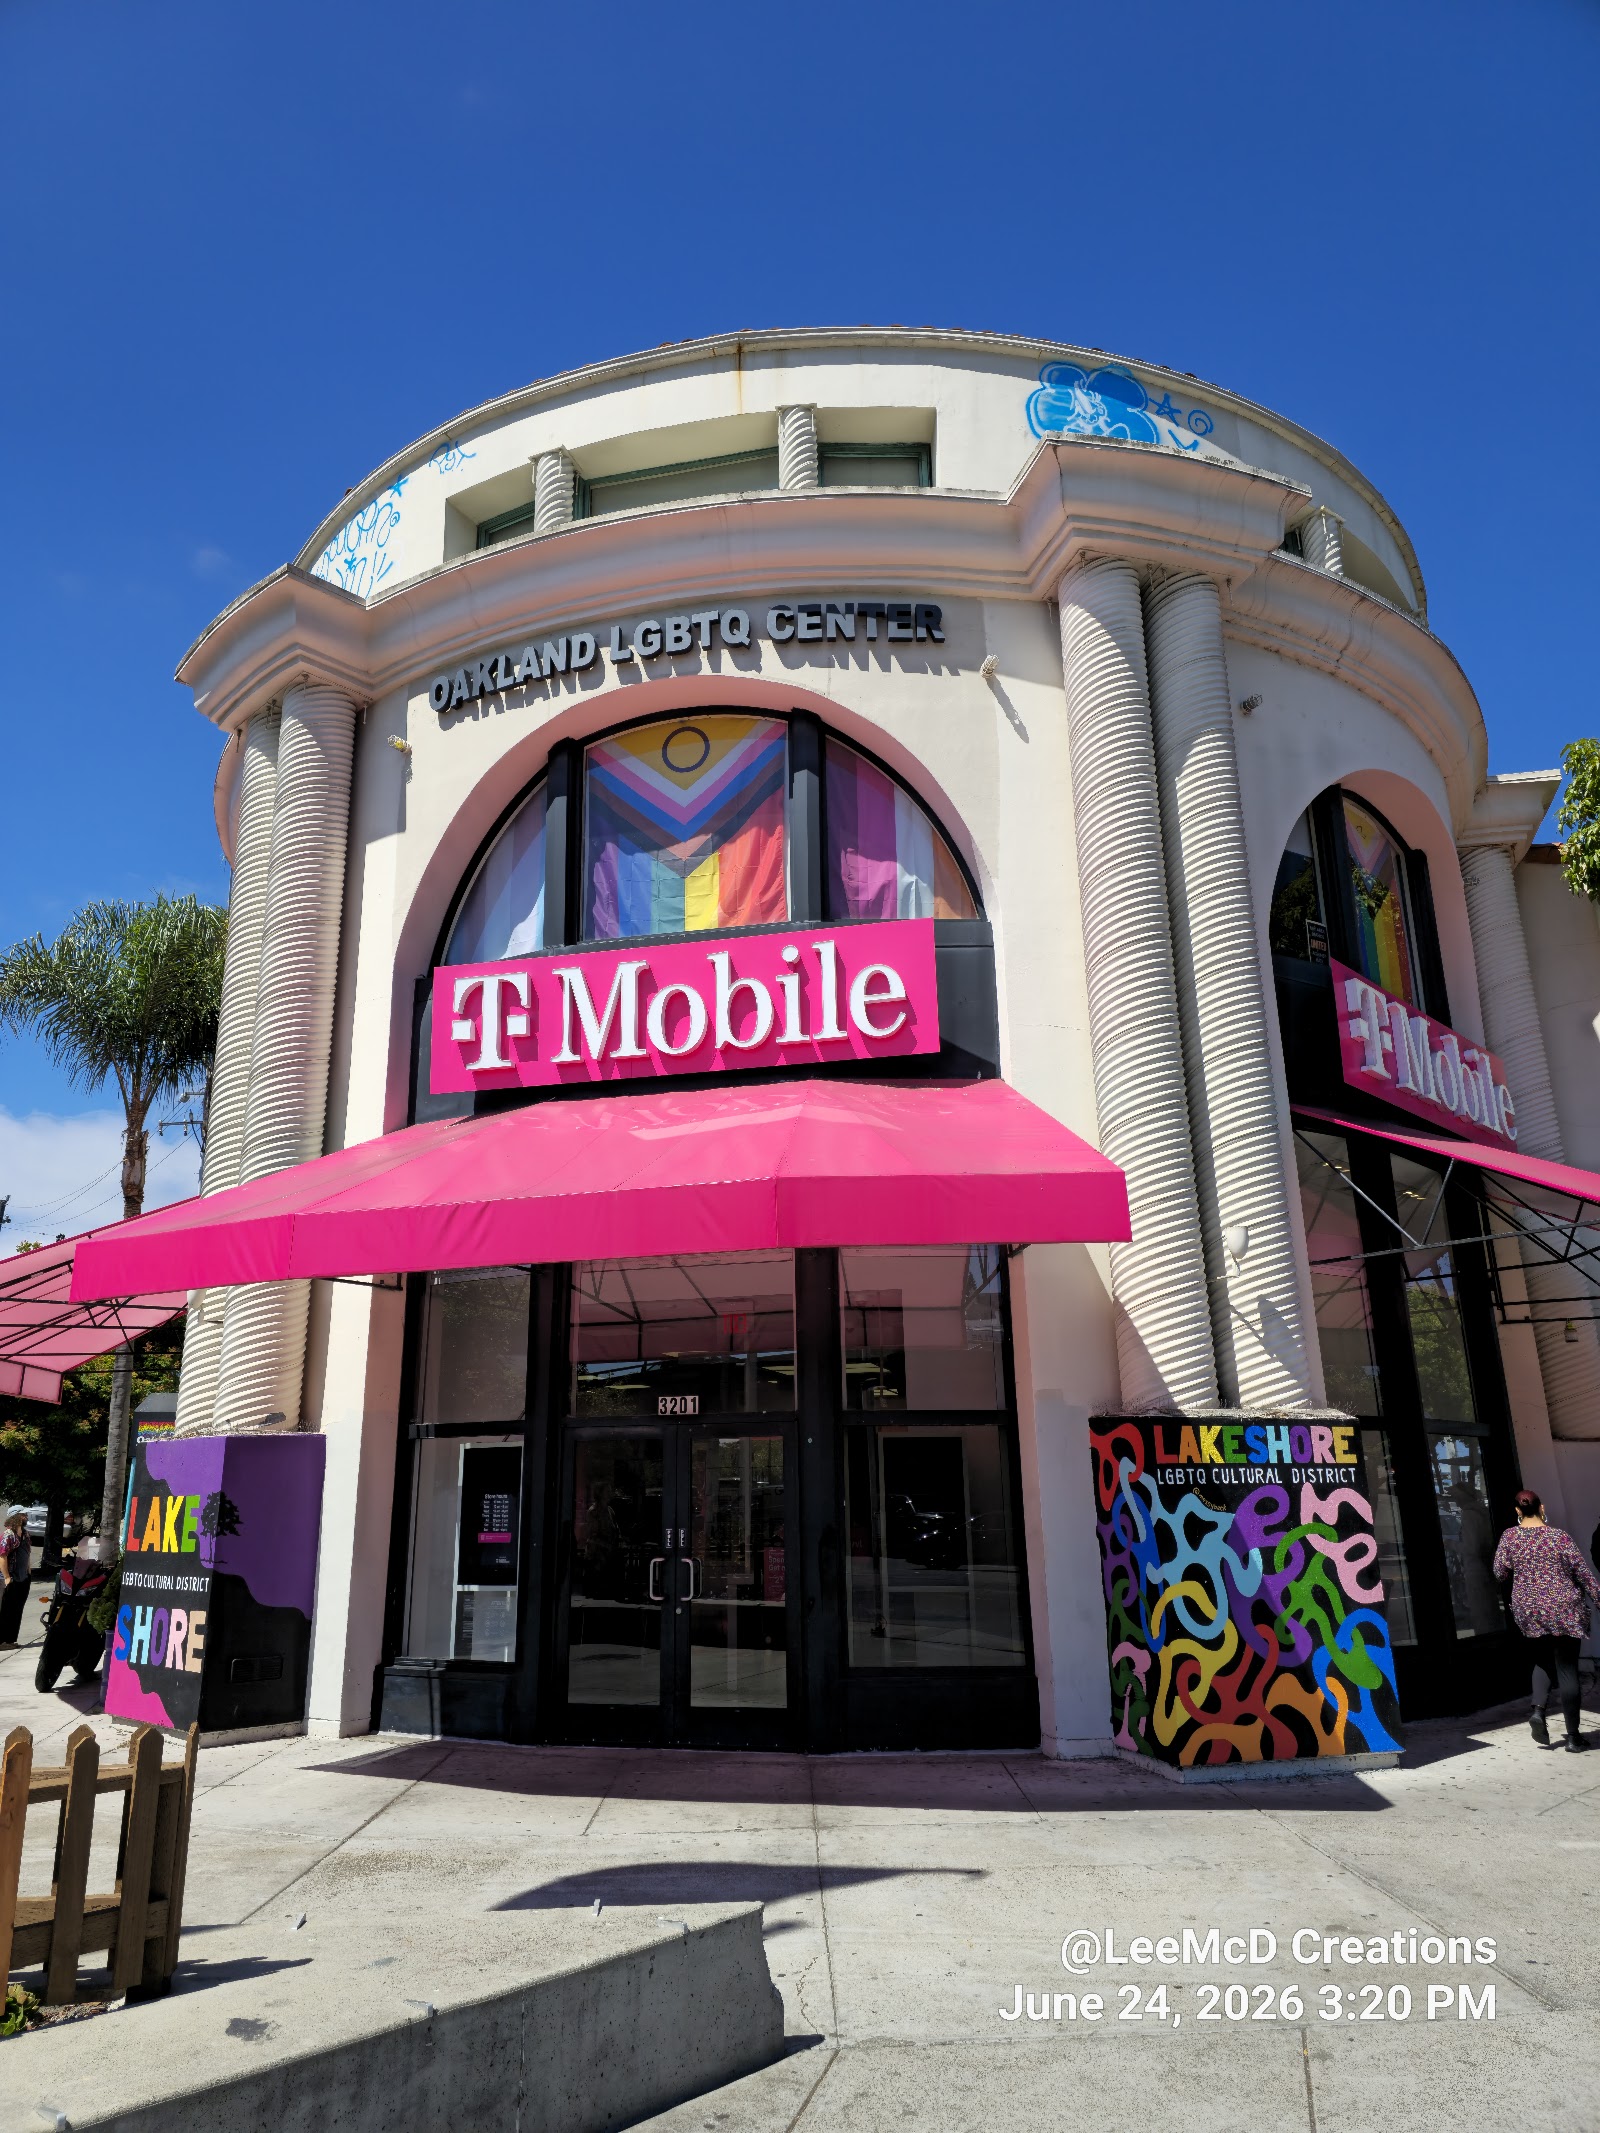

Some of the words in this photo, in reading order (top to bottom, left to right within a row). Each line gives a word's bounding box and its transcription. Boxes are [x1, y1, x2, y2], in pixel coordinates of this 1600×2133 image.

[428, 632, 596, 714] OAKLAND
[609, 608, 751, 665] LGBTQ
[766, 603, 946, 644] CENTER
[1310, 938, 1327, 952] UNITED
[550, 939, 908, 1064] Mobile
[1387, 1001, 1518, 1141] Mobile
[659, 1396, 697, 1415] 3201
[1153, 1425, 1358, 1464] LAKESHORE
[1157, 1468, 1207, 1485] LGBTQ
[1212, 1468, 1283, 1485] CULTURAL
[1292, 1467, 1357, 1485] DISTRICT
[126, 1494, 201, 1553] LAKE
[121, 1571, 143, 1587] LGBTQ
[143, 1573, 174, 1590] CULTURAL
[176, 1576, 210, 1593] DISTRICT
[115, 1604, 207, 1673] SHORE
